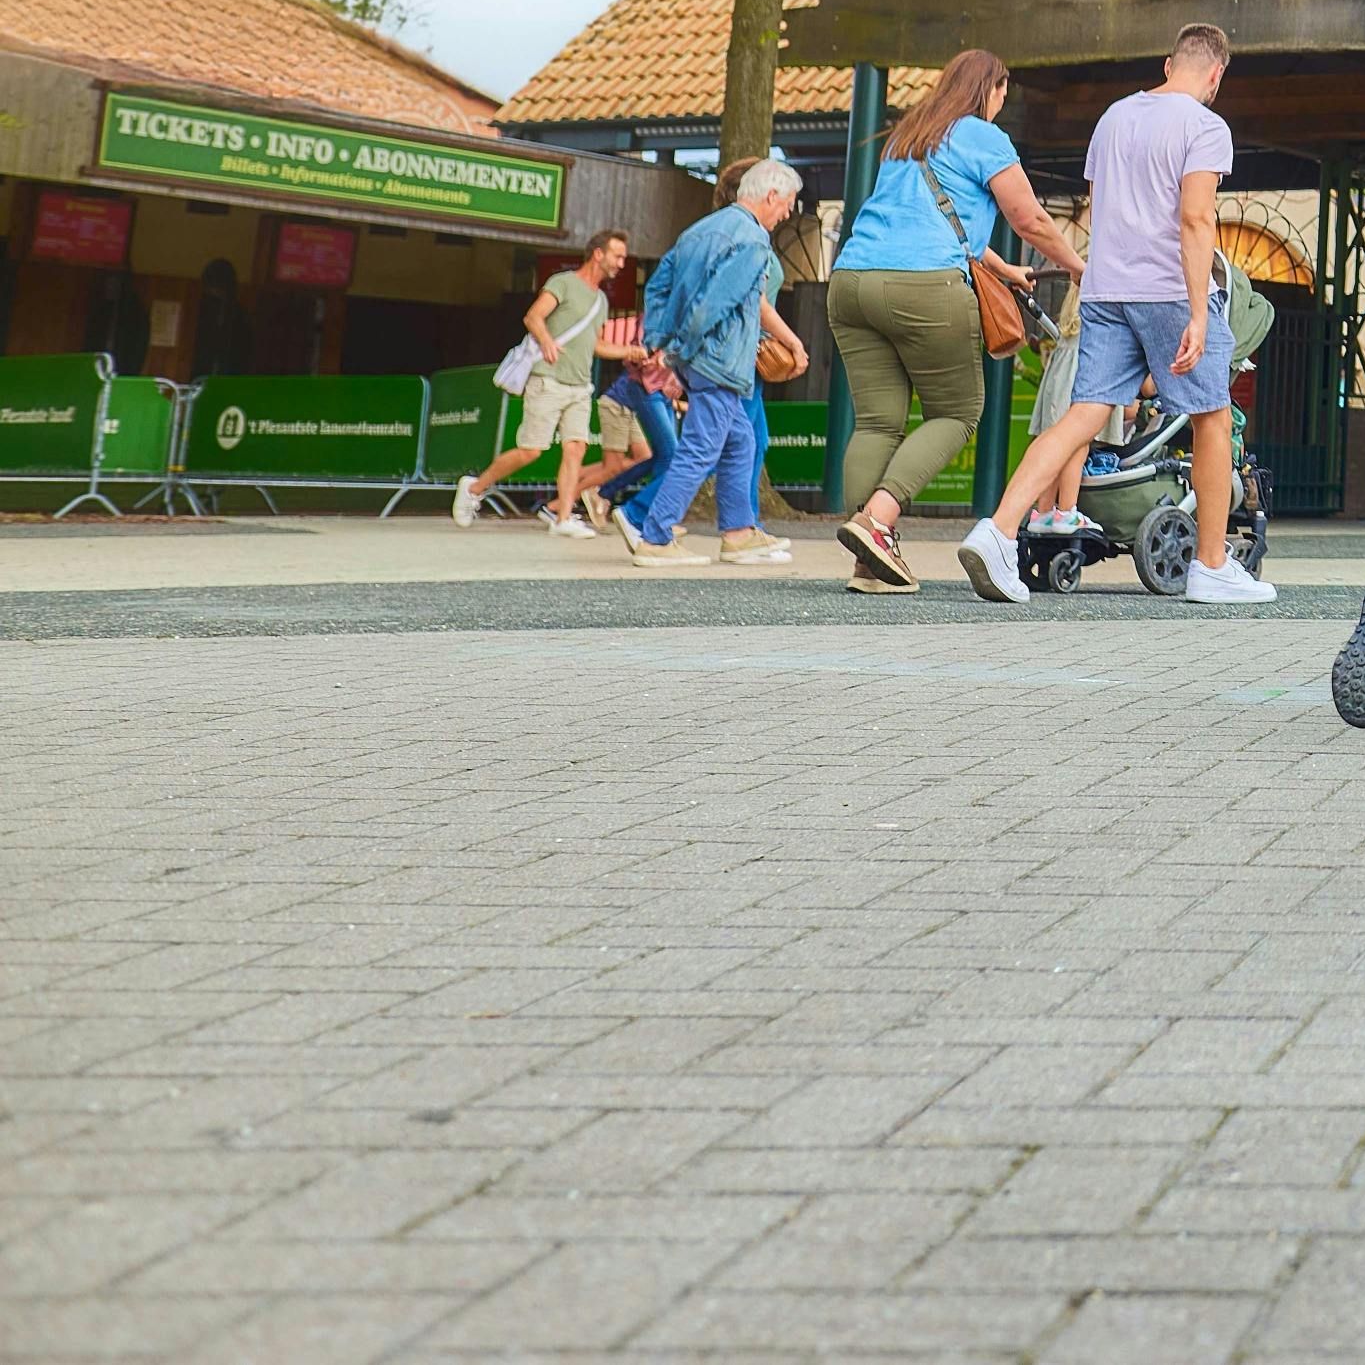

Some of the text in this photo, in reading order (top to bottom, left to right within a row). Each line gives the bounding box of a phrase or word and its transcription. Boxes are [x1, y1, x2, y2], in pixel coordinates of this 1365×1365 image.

[116, 108, 553, 199] TICKETS INFO ABONNEMENTEN
[220, 155, 472, 205] Billets Informations Abonnements
